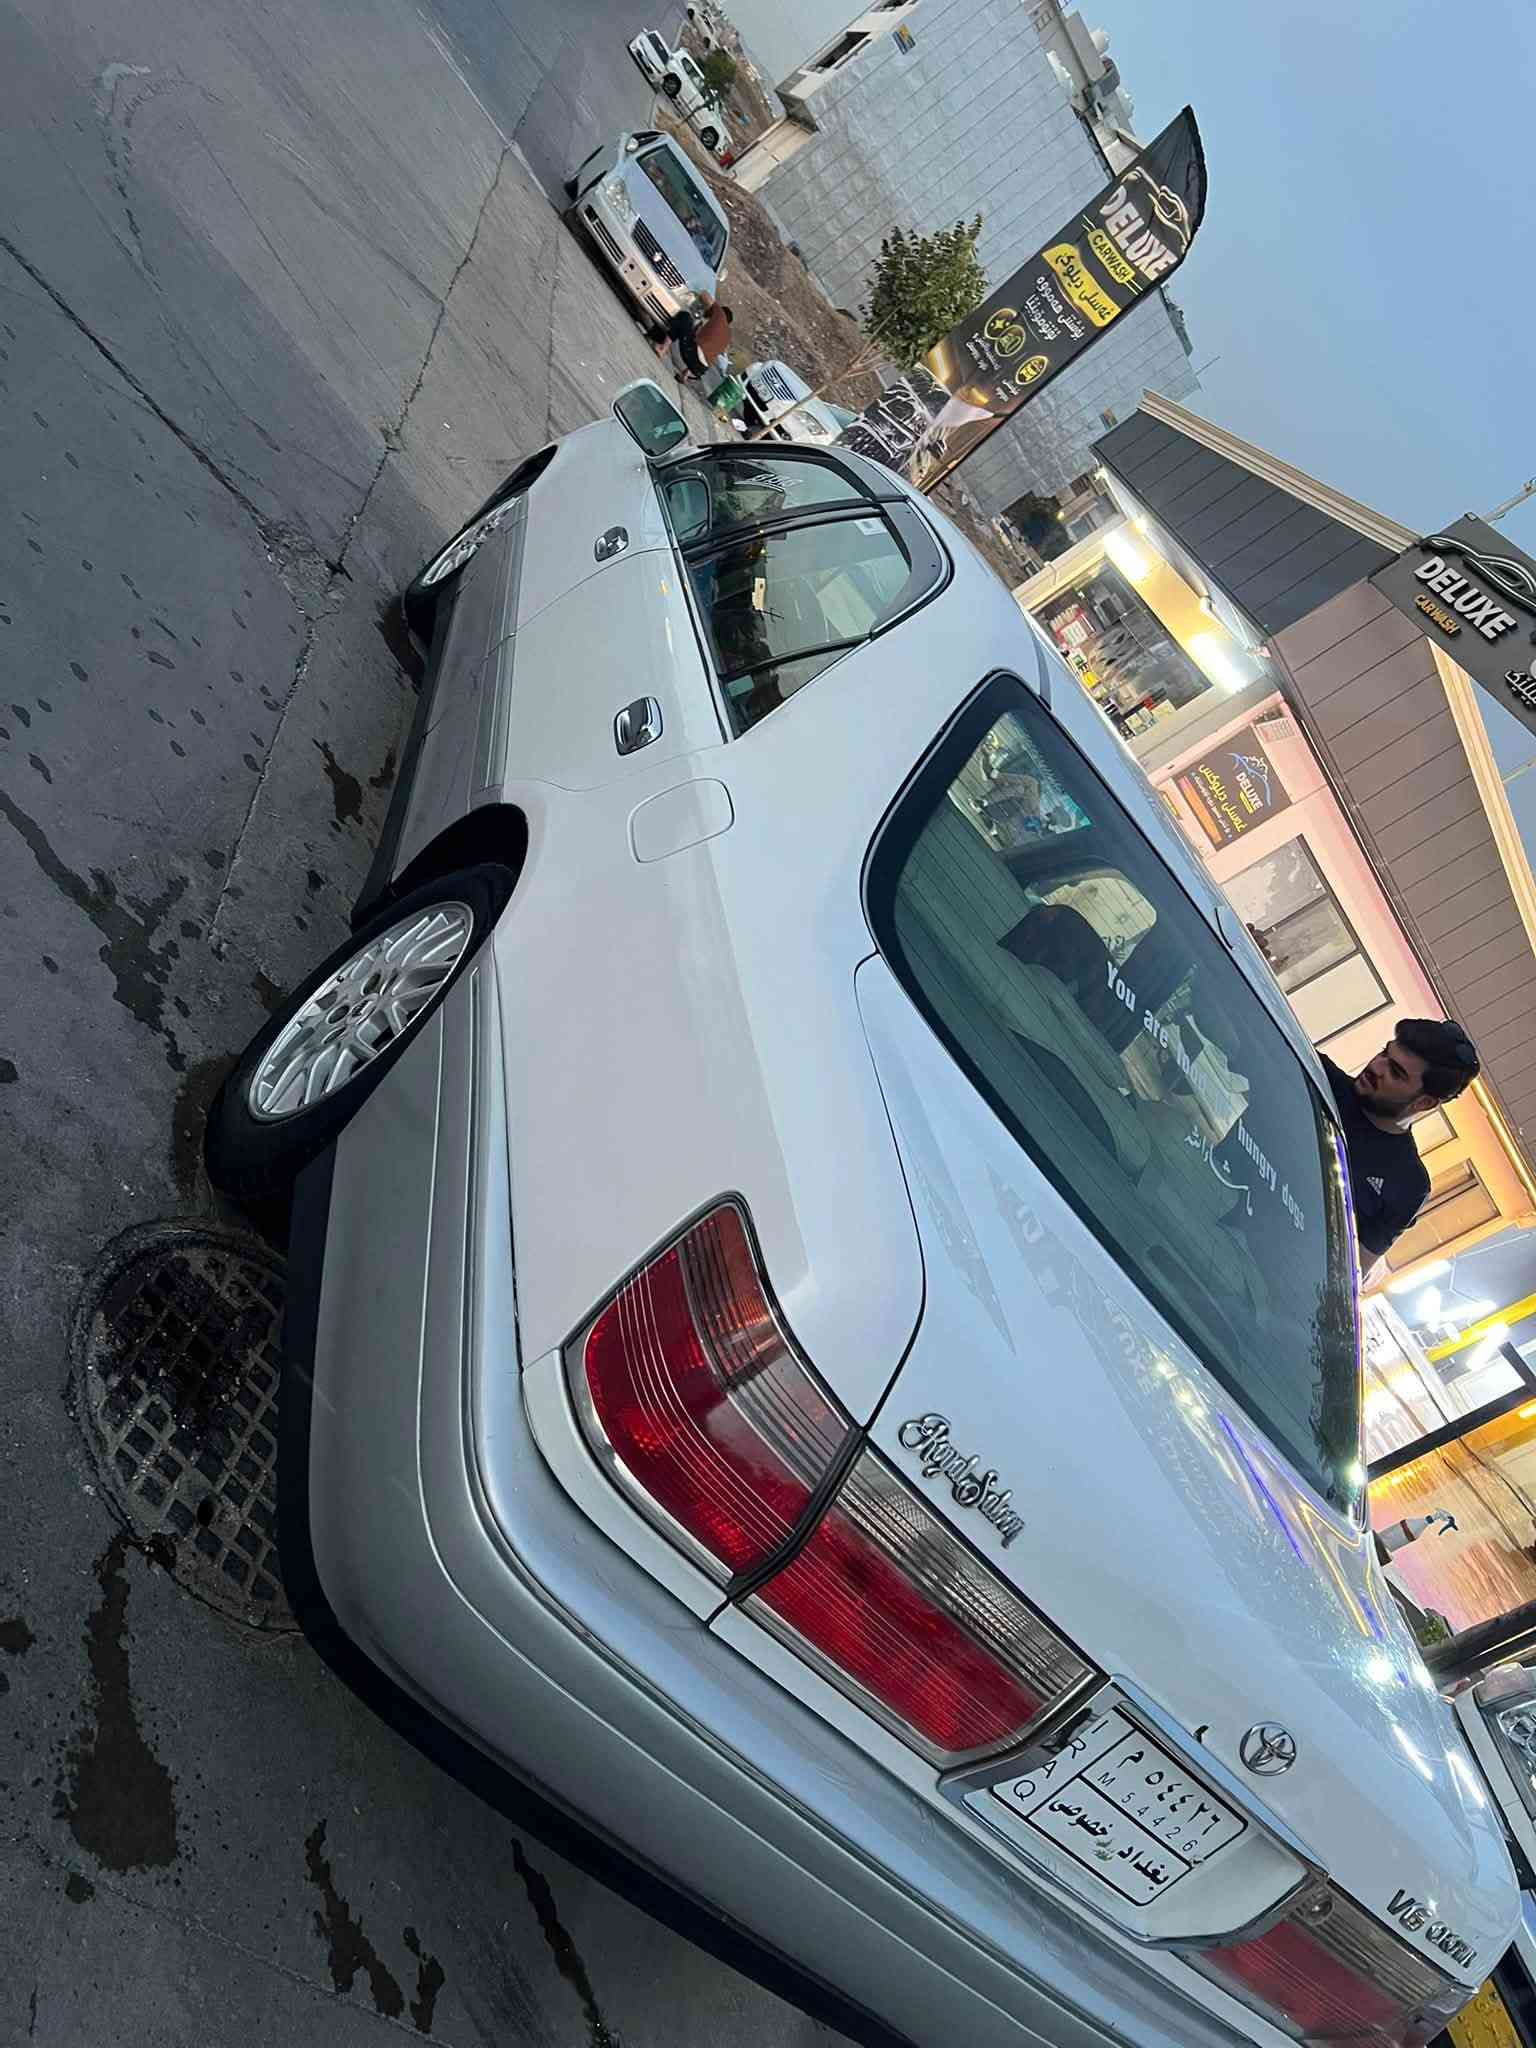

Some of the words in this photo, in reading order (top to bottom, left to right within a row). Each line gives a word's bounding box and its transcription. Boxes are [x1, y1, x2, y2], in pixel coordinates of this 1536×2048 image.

[1100, 185, 1178, 281] DELUXE
[1093, 234, 1129, 279] CARWASH
[1414, 556, 1517, 640] DELUXE
[1415, 594, 1461, 634] CARWASH
[1235, 772, 1264, 810] DELUXE
[1107, 961, 1136, 1012] You
[1143, 1009, 1169, 1049] are
[1237, 1117, 1278, 1192] hungry
[898, 1413, 980, 1481] Royal
[1118, 1846, 1169, 1891] بغداد
[1387, 1889, 1433, 1932] V6
